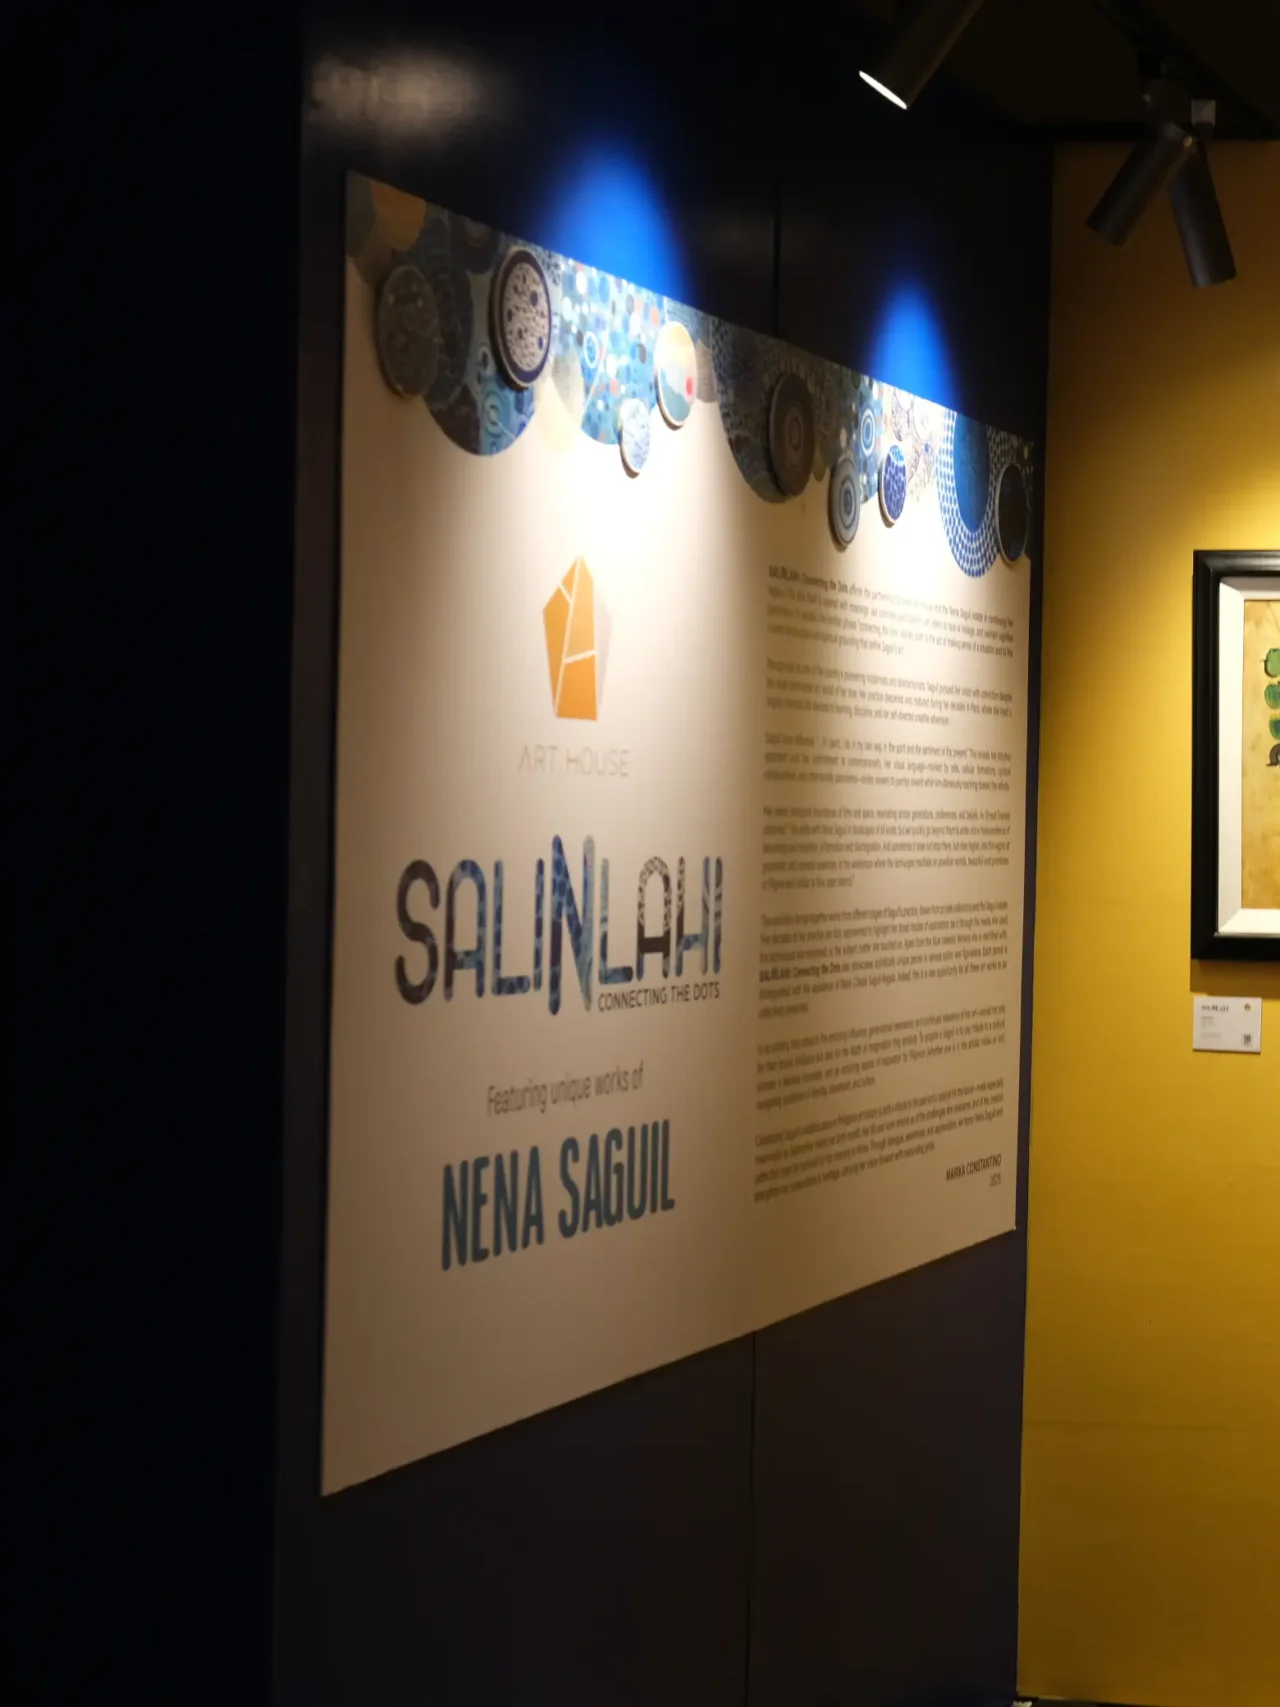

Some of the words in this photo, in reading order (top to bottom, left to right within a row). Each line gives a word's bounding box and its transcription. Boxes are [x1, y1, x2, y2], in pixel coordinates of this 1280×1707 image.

[518, 744, 558, 775] ART
[565, 746, 630, 777] HOUSE
[394, 834, 724, 1015] SALINLAHI
[598, 986, 668, 1012] CONNECTING
[671, 983, 690, 1003] THE
[693, 981, 721, 1001] DOTS
[487, 1078, 547, 1117] Featuring
[551, 1070, 591, 1109] unique
[595, 1066, 630, 1097] works
[632, 1060, 644, 1090] of
[442, 1145, 544, 1271] NENA
[558, 1119, 676, 1238] SAGUIL
